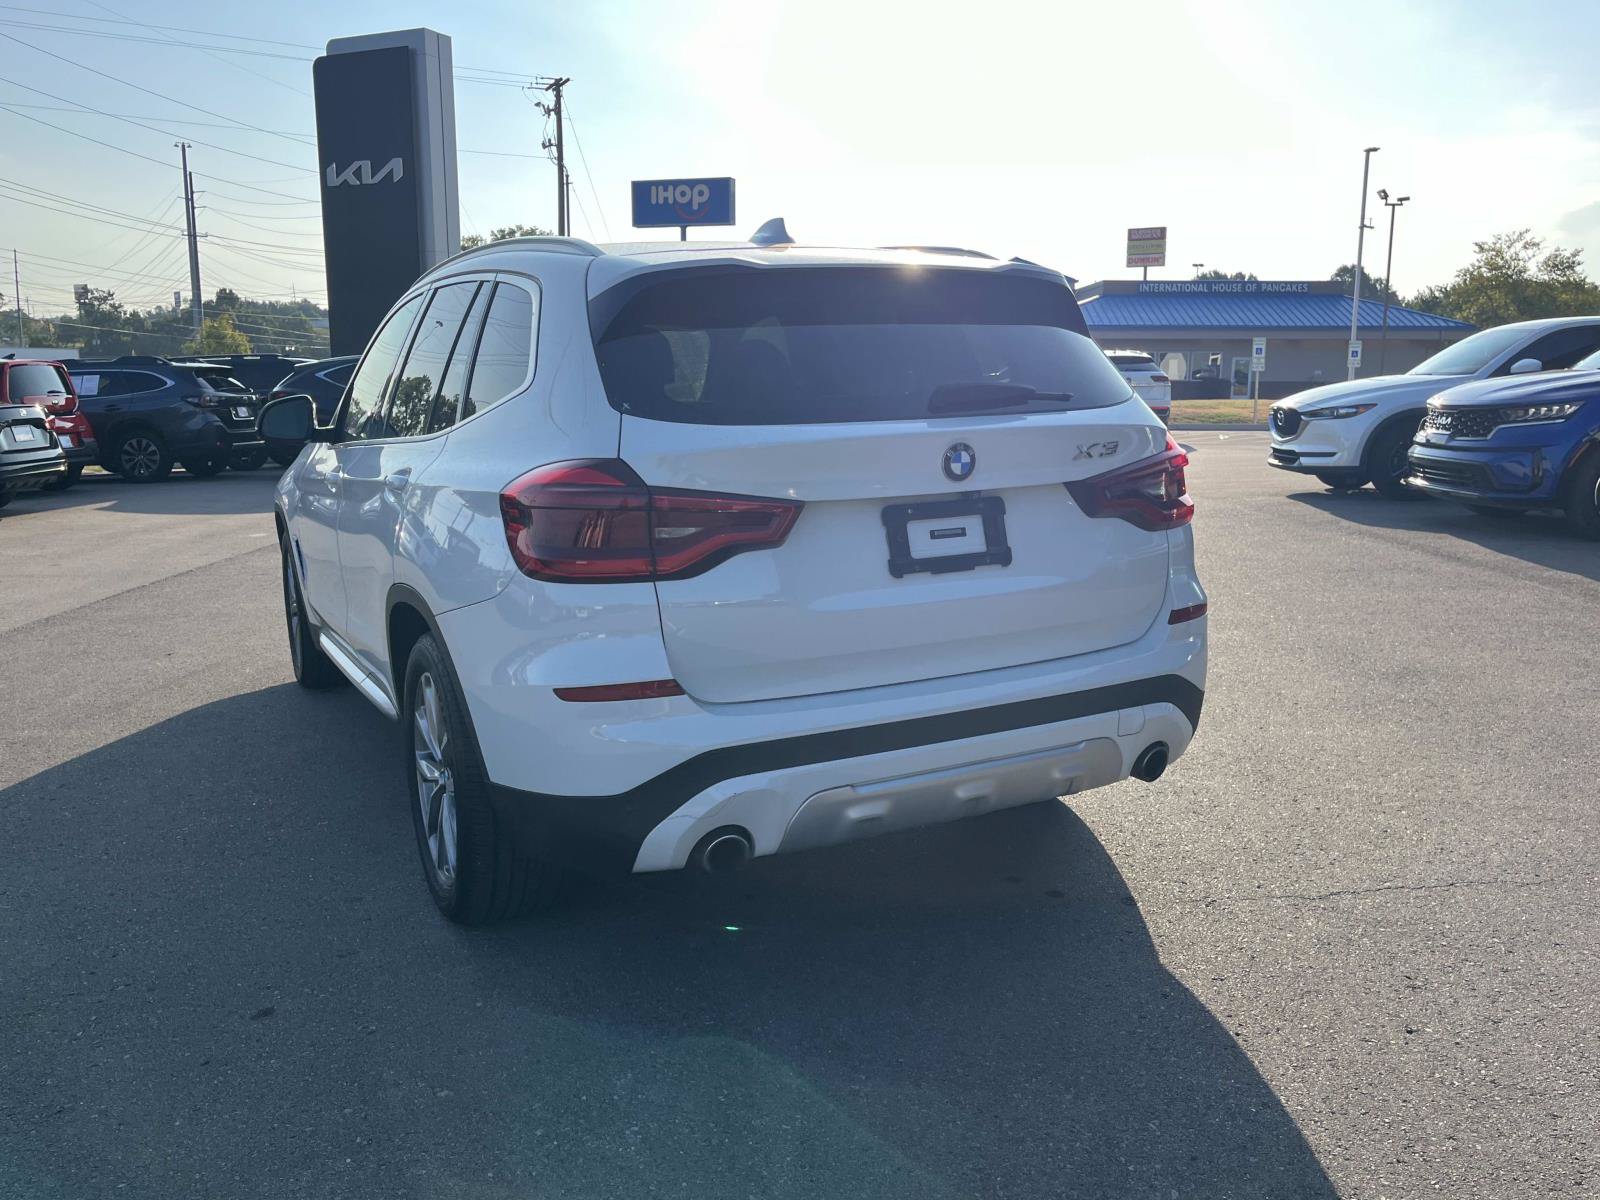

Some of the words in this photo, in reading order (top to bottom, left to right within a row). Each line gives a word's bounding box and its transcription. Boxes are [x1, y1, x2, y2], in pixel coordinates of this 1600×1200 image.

[326, 157, 404, 187] KIA
[1139, 283, 1209, 293] INTERNATIONAL
[1212, 283, 1242, 293] HOUSE
[1245, 283, 1257, 293] OF
[1261, 283, 1308, 293] PANCAKES
[1072, 440, 1119, 461] X3
